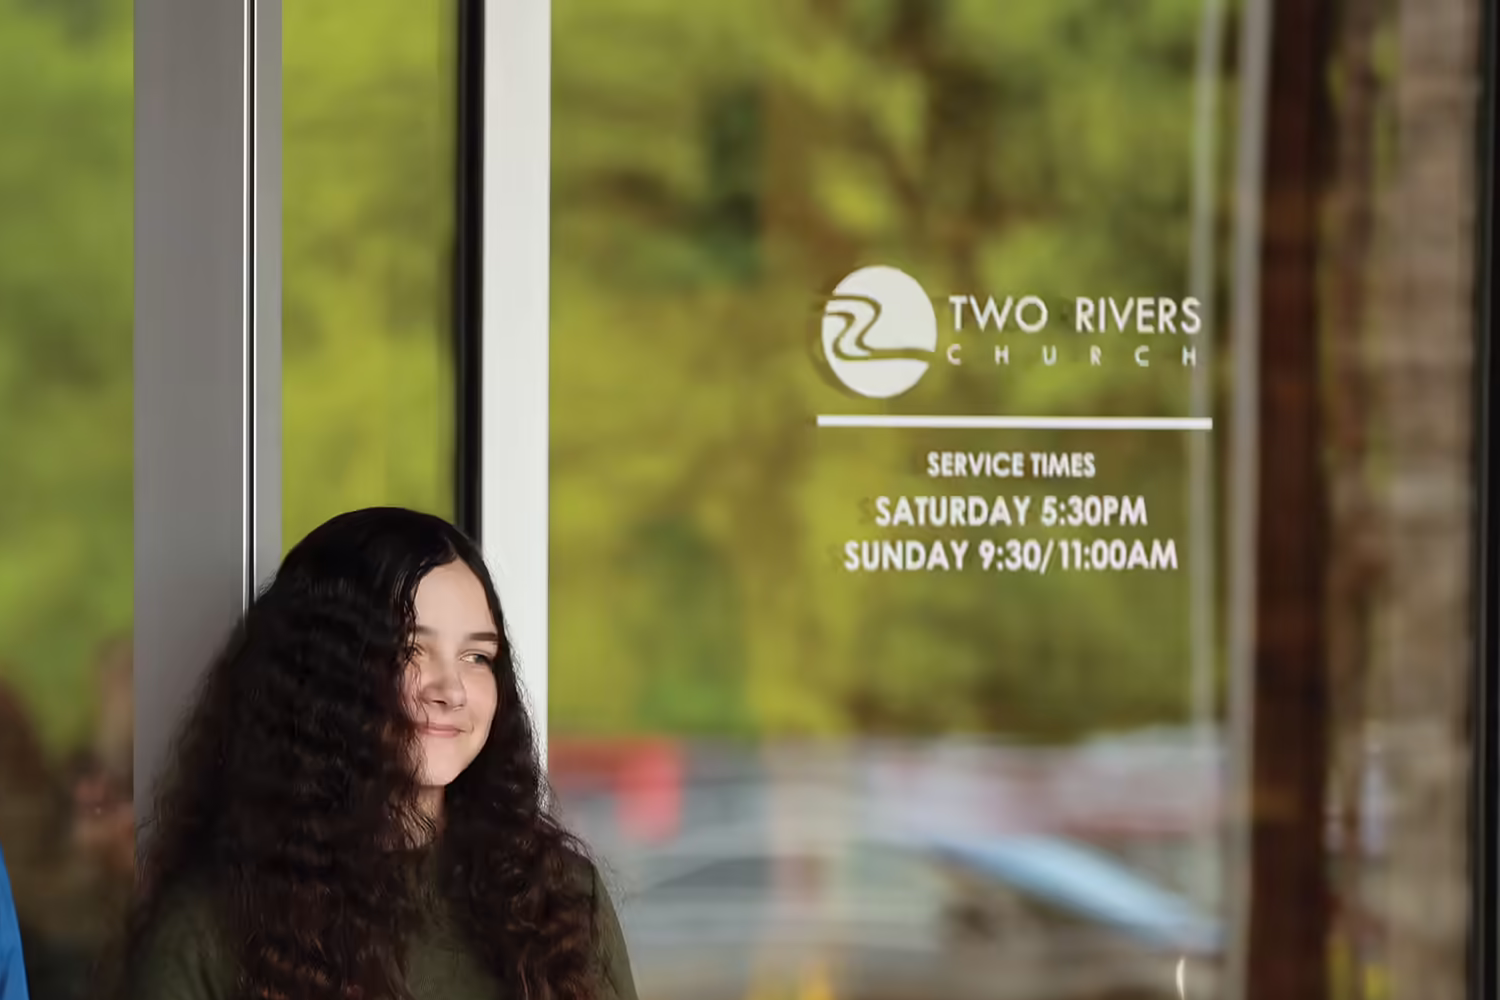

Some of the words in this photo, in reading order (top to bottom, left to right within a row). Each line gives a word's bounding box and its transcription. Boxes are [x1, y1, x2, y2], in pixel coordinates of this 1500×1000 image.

[948, 295, 1049, 332] TWO
[1075, 297, 1202, 334] RIVERS
[946, 344, 1197, 367] CHURCH
[927, 452, 1024, 477] SERVICE
[1030, 453, 1096, 478] TIMES
[875, 496, 1030, 526] SATURDAY
[1041, 496, 1148, 526] 5:30PM
[844, 541, 968, 571] SUNDAY
[979, 539, 1179, 574] 9:30/11:00AM
